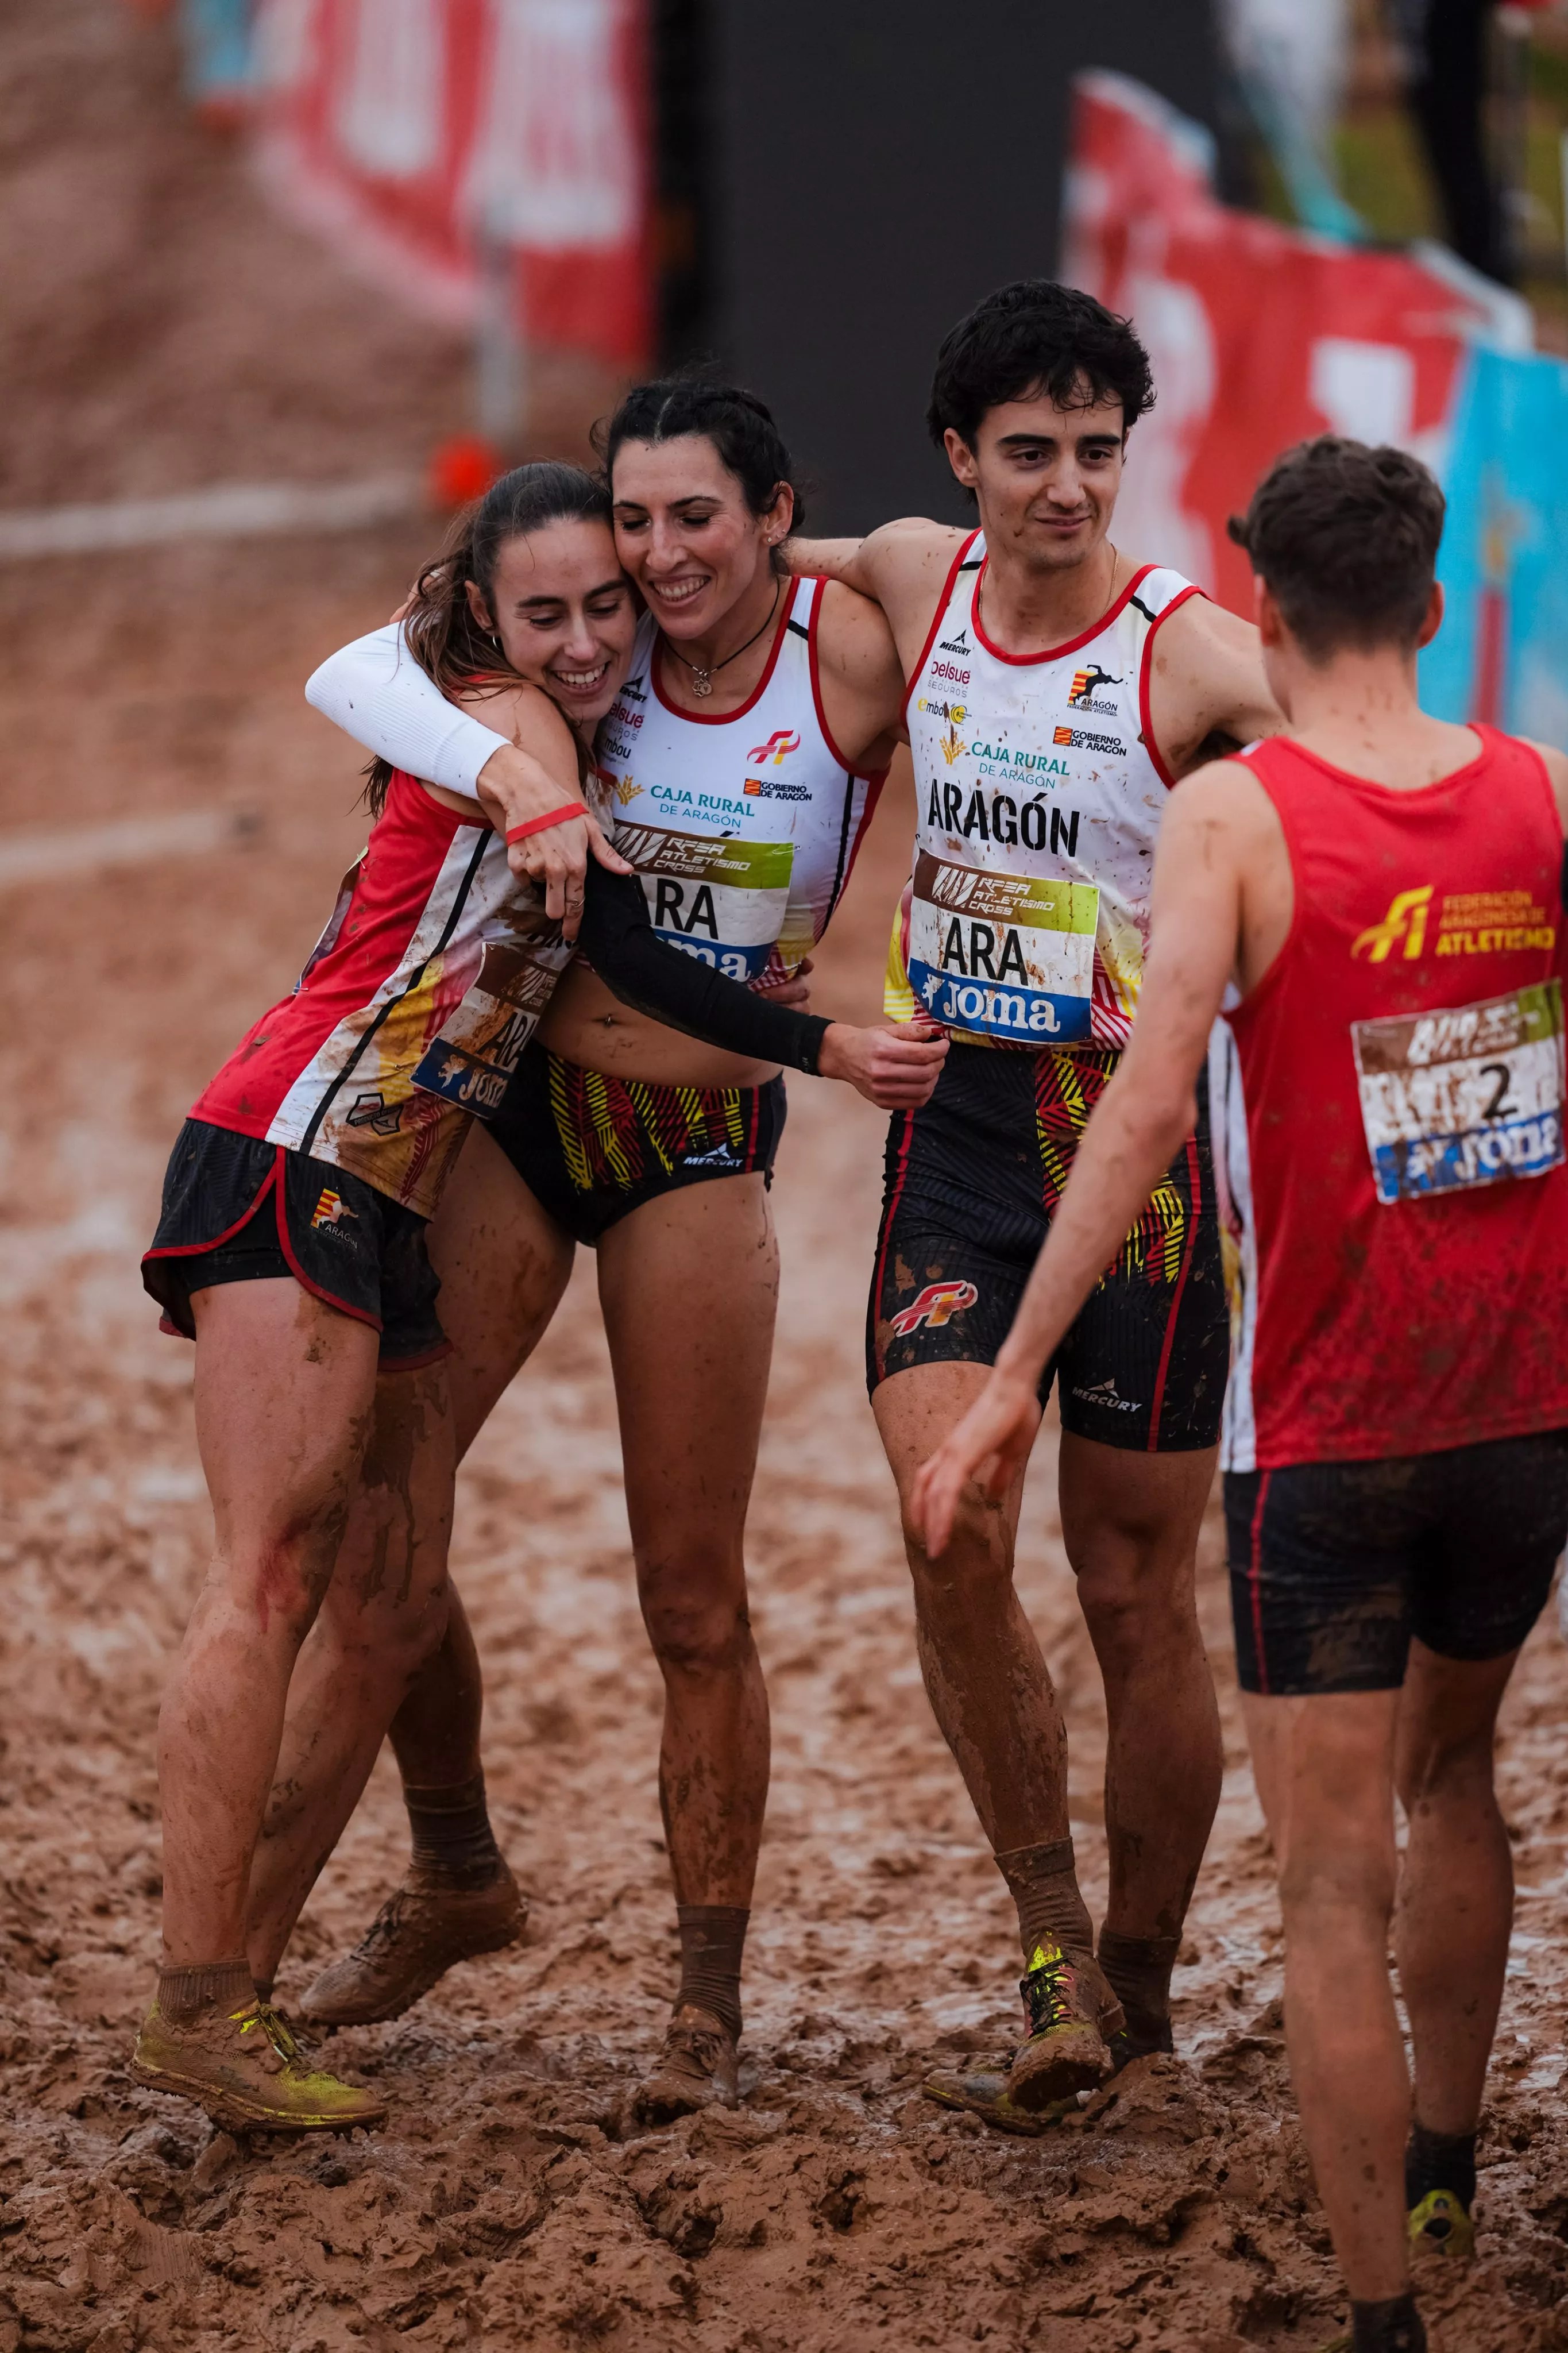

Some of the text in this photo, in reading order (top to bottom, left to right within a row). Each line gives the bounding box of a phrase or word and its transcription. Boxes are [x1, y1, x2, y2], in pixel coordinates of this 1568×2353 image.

[939, 642, 971, 656] MERCURY
[619, 685, 648, 703] ERCURY
[928, 680, 967, 698] SEGUROS
[1067, 704, 1092, 712] FEDERACIÓN
[1081, 698, 1118, 711] ARAGÓN
[608, 721, 638, 741] GUROS
[1073, 730, 1121, 746] GOBIERNO
[1071, 739, 1127, 757] DE ARAGON
[971, 742, 1070, 776] CAJA RURAL
[979, 763, 1055, 789] DE ARAGÓN
[760, 790, 773, 798] DE
[761, 782, 807, 793] GOBIERNO
[650, 785, 755, 817] CAJA RURAL
[659, 804, 741, 828] DE ARAGÓN
[928, 778, 1080, 857] ARAGÓN
[667, 837, 727, 855] RFEA
[653, 859, 706, 874] CROSS
[660, 850, 751, 871] ATLETISMO
[978, 877, 1032, 895] RFEA
[968, 900, 1013, 915] CROSS
[973, 890, 1056, 911] ATLETISMO
[942, 917, 1029, 986] ARA
[459, 1066, 508, 1109] Jom
[1480, 1064, 1518, 1119] 2
[682, 1156, 743, 1167] MERCURY
[1072, 1386, 1143, 1412] MERCURY
